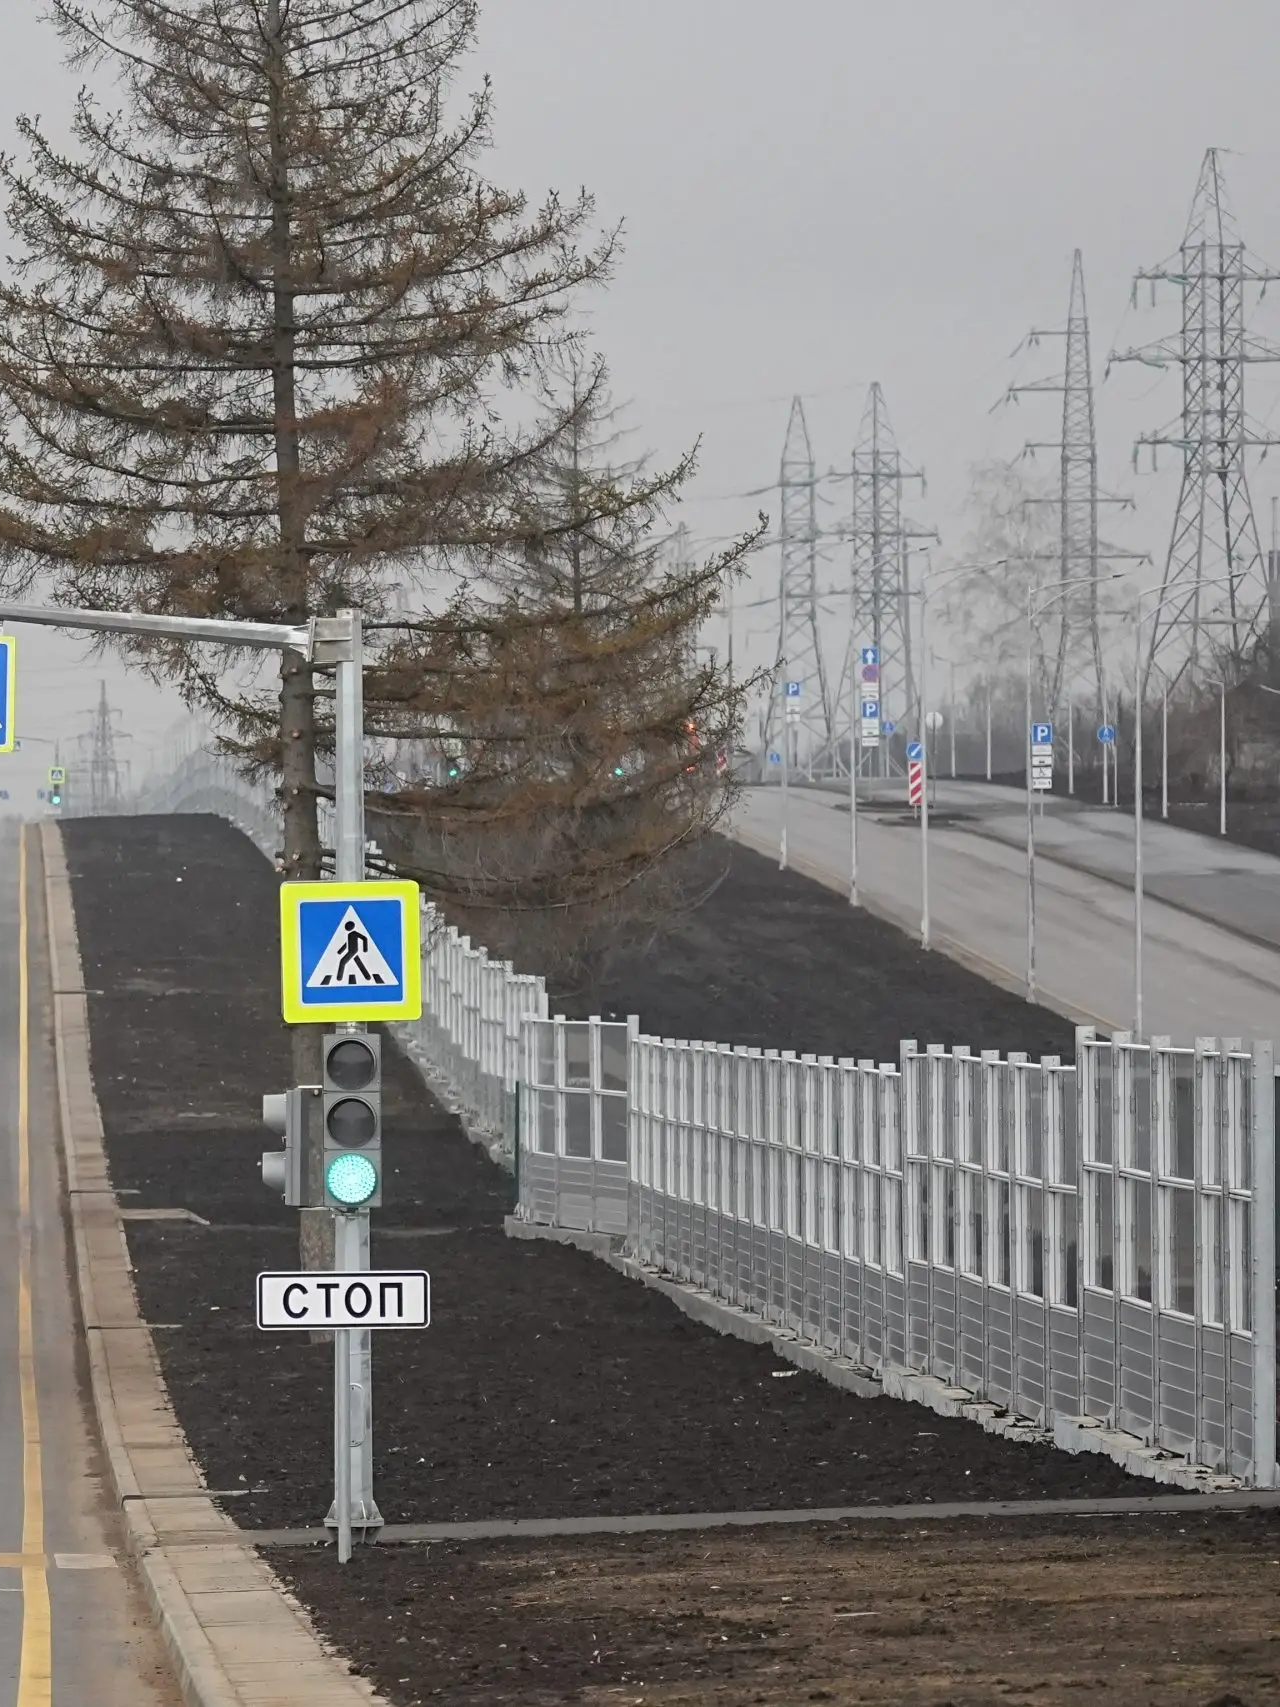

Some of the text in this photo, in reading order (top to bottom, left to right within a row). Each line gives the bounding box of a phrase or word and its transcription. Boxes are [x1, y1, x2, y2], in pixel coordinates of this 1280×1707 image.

[789, 683, 798, 695] P
[866, 703, 876, 717] P
[1037, 726, 1049, 741] P
[283, 1282, 403, 1319] СТОП
